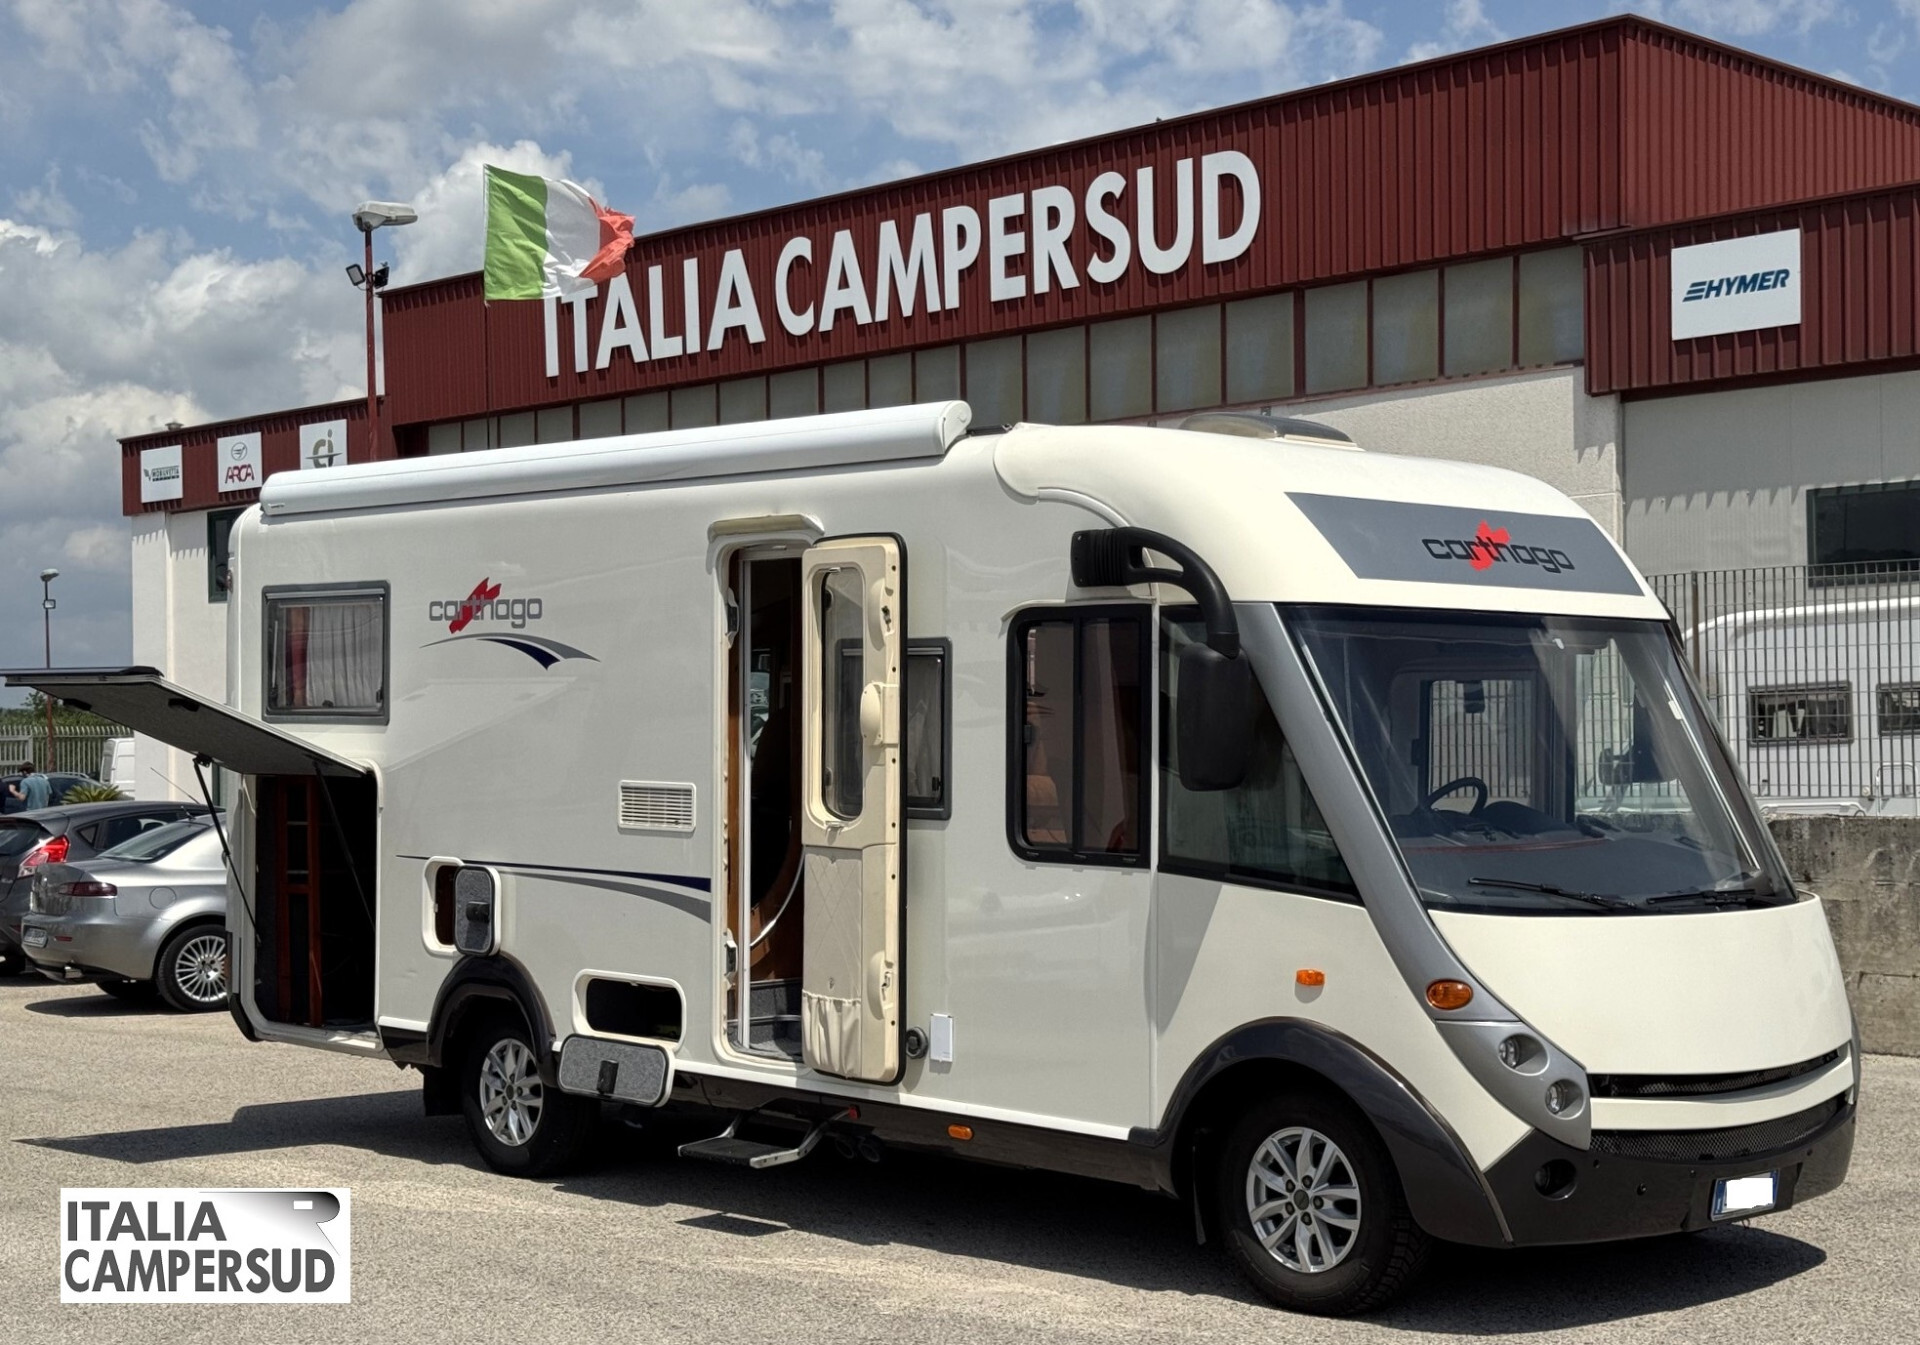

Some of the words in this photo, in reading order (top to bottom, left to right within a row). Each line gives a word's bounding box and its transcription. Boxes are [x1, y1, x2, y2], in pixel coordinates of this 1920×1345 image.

[544, 249, 766, 377] ITALIA
[775, 150, 1261, 337] CAMPERSUD
[1704, 268, 1790, 299] HYMER
[225, 463, 255, 484] ARCA
[1421, 535, 1576, 574] carthago
[429, 594, 543, 629] carthago
